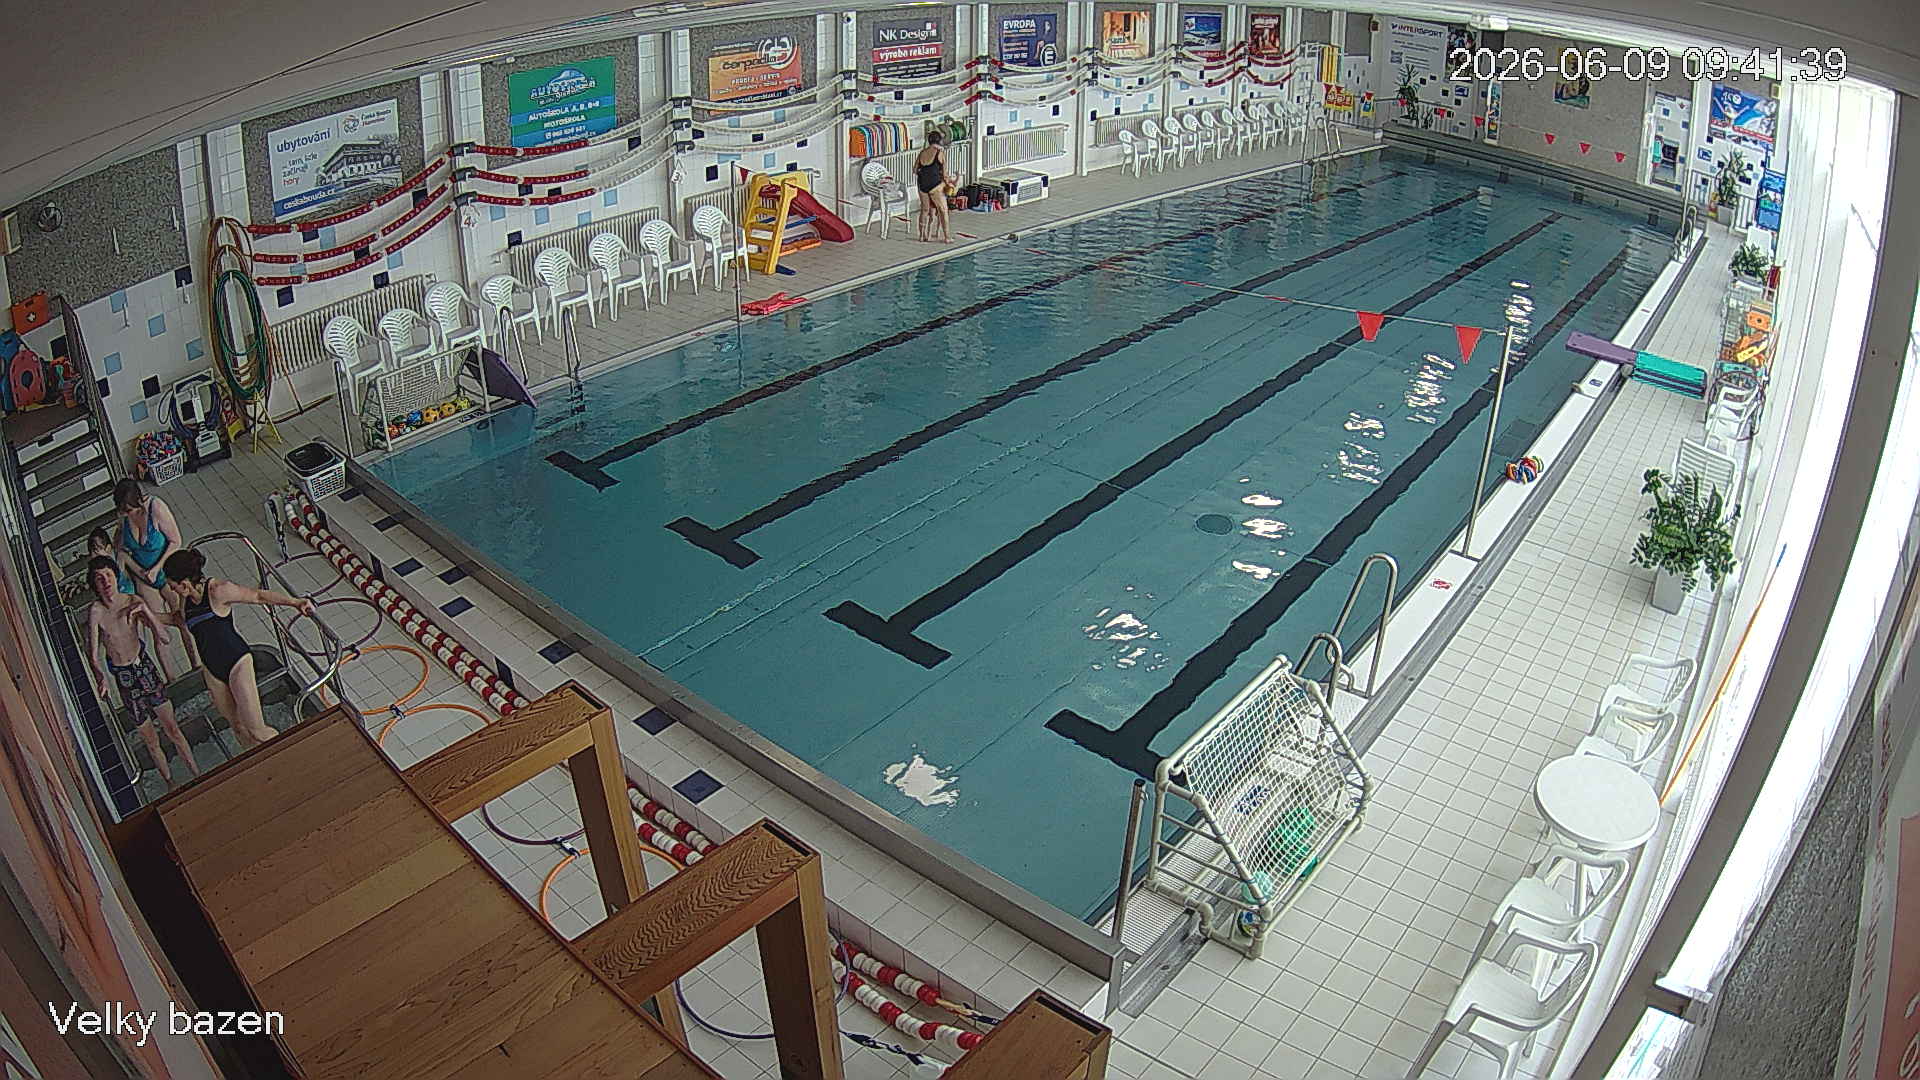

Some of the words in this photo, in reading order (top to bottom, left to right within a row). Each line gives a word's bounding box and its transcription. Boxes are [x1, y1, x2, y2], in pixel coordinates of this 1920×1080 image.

[1003, 19, 1036, 29] EVROPA
[1398, 24, 1444, 38] INTERSPORT
[879, 29, 898, 42] NK
[900, 29, 934, 41] Design
[879, 48, 908, 61] výroba
[909, 46, 937, 57] reklam
[276, 128, 332, 153] ubytování
